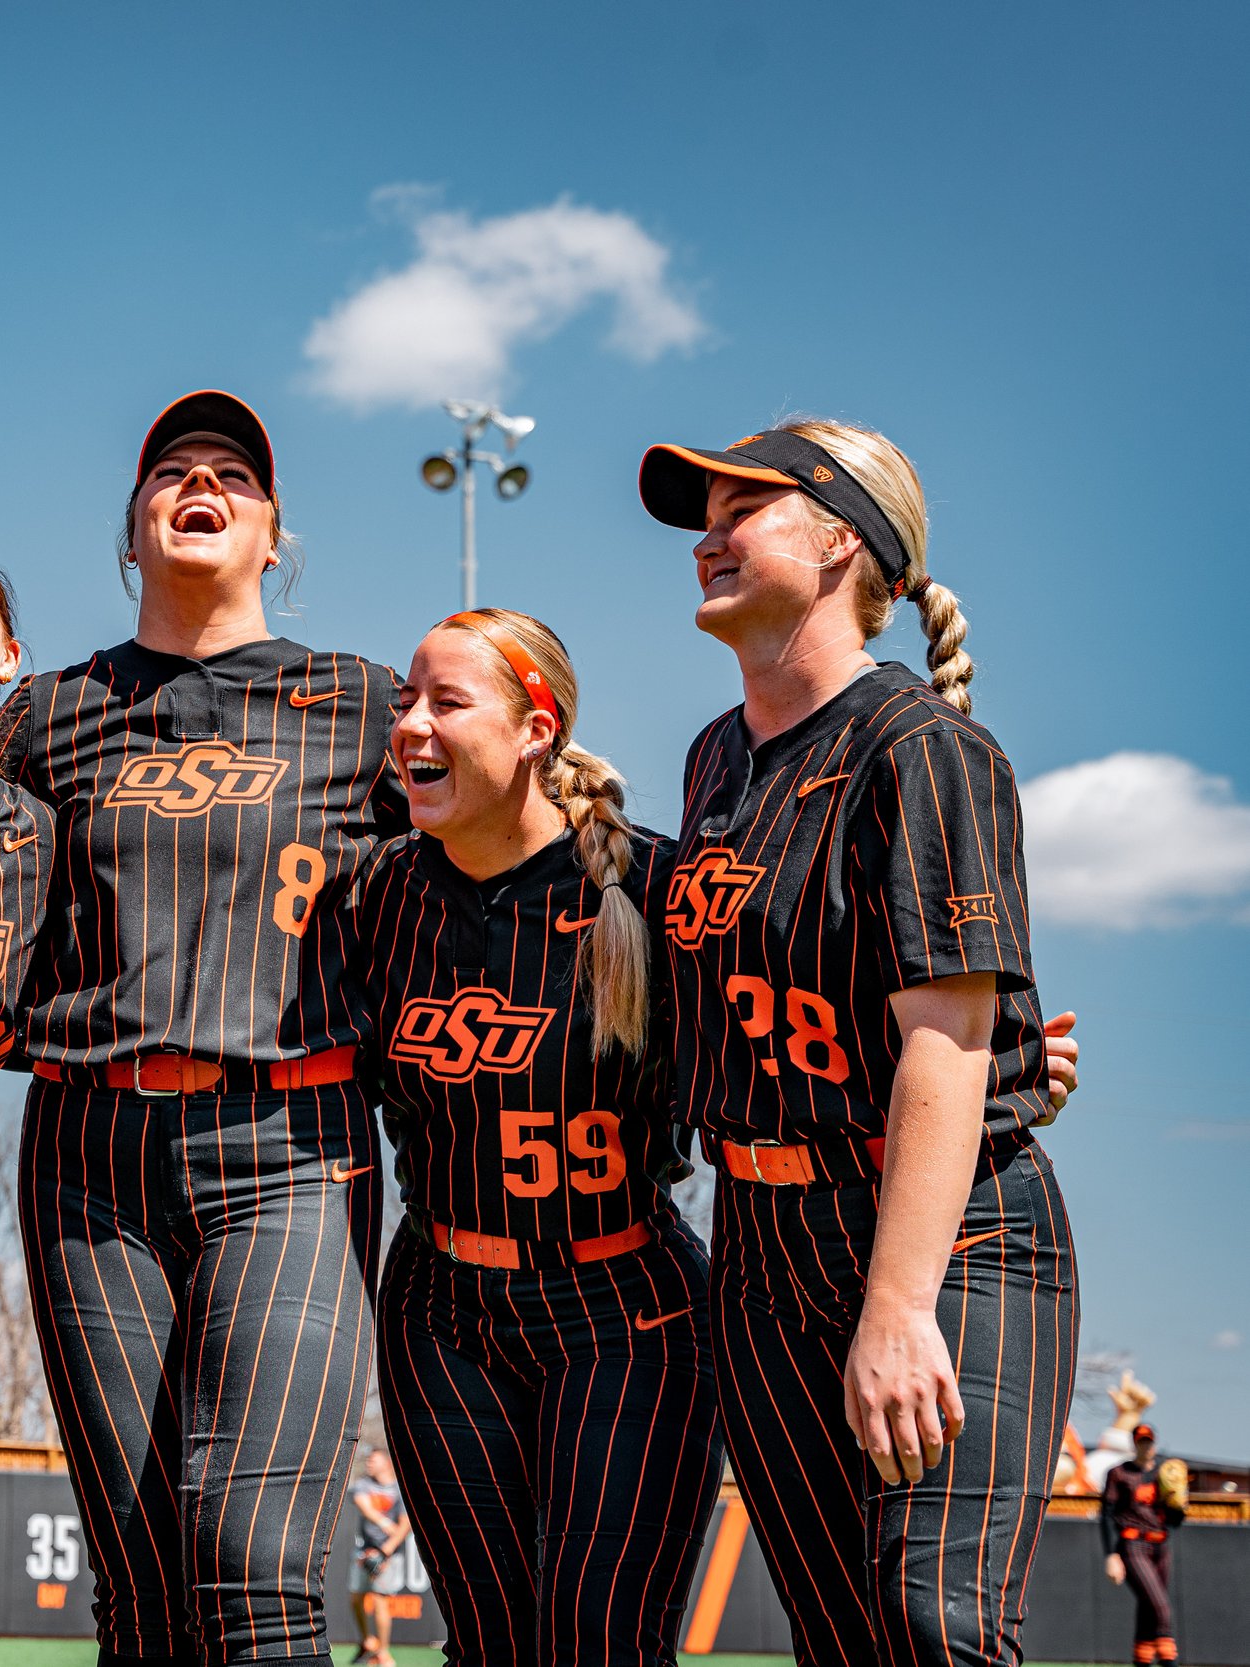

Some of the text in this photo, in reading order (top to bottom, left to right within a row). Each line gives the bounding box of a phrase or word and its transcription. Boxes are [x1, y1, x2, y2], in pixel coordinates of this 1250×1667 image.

[102, 741, 290, 818] OSU
[272, 842, 326, 939] 8
[665, 847, 767, 950] OSU
[388, 986, 557, 1084] OSU
[500, 1110, 627, 1198] 59
[26, 1513, 80, 1581] 35
